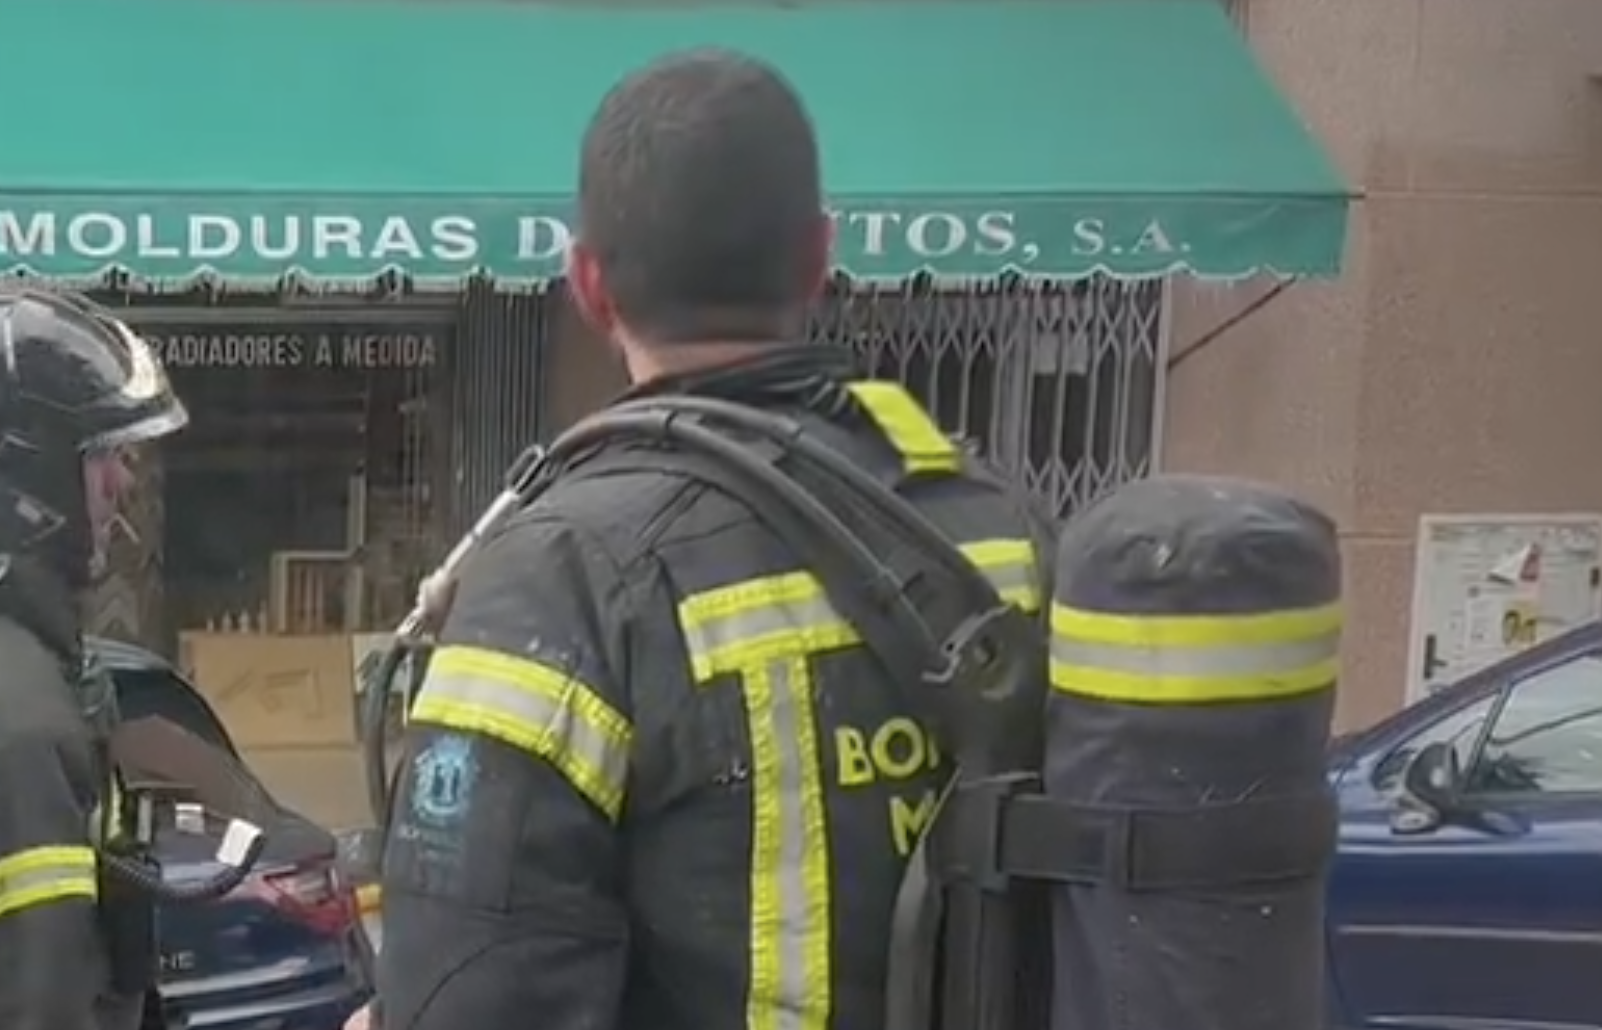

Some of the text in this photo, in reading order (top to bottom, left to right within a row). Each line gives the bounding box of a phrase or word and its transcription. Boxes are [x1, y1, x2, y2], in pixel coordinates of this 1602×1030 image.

[824, 209, 1041, 264] TOS,
[1071, 216, 1193, 256] S.A.
[315, 334, 333, 367] A
[342, 334, 436, 368] MEDIDA
[834, 716, 940, 786] BO
